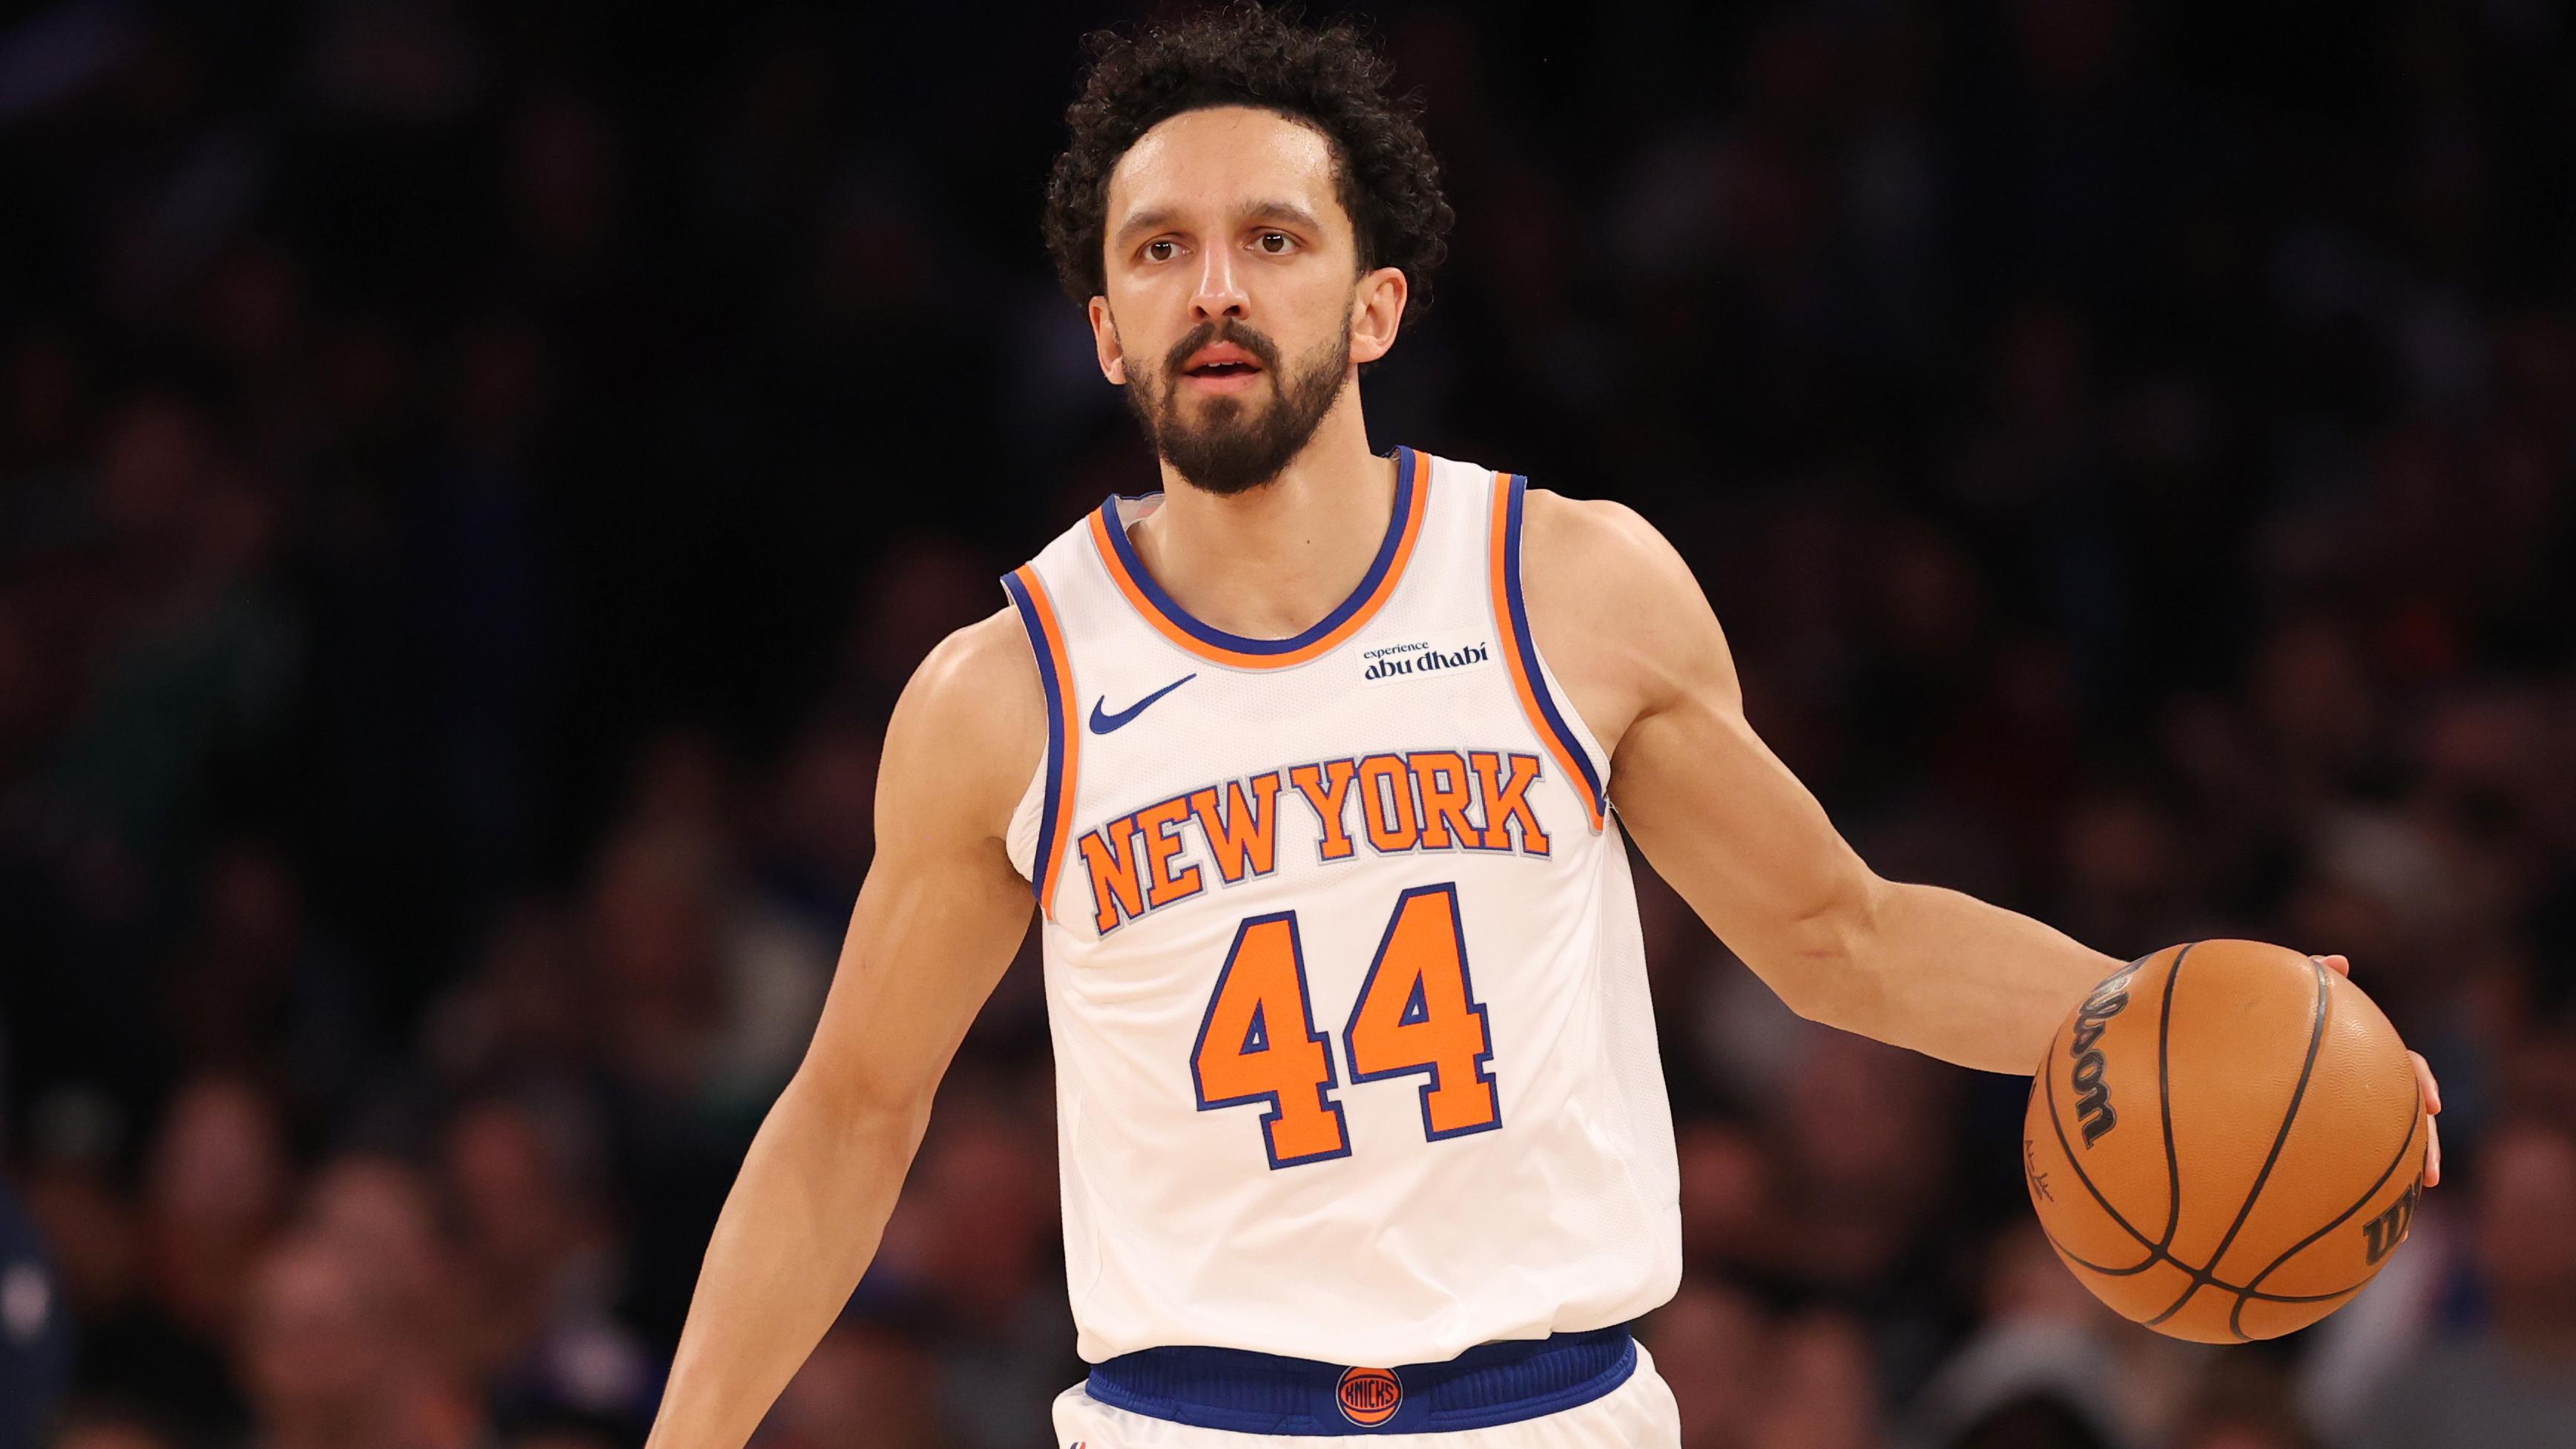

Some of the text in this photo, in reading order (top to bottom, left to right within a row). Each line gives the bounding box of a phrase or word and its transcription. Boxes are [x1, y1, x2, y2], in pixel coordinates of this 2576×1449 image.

[1363, 642, 1429, 659] experience
[1365, 658, 1413, 680] abu
[1076, 747, 1552, 940] NEW YORK
[1190, 881, 1503, 1170] 44
[1345, 1379, 1394, 1408] KNICKS
